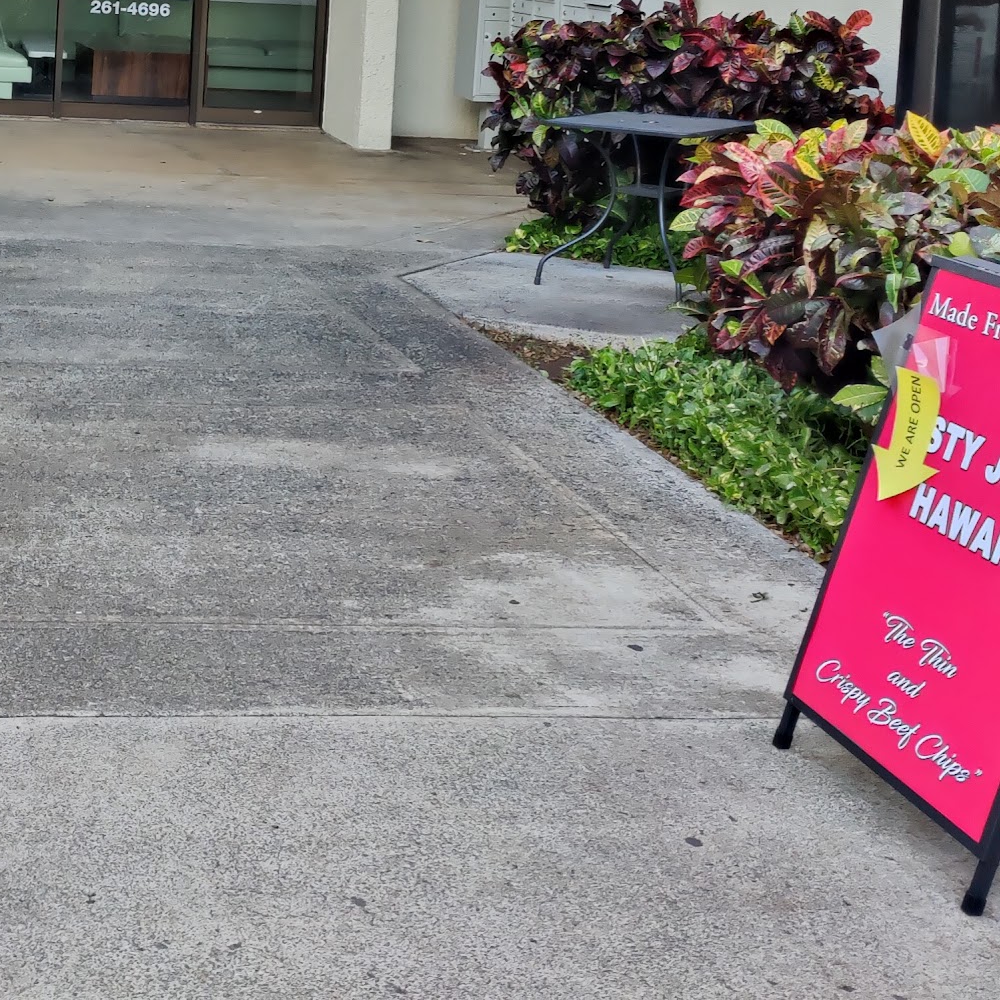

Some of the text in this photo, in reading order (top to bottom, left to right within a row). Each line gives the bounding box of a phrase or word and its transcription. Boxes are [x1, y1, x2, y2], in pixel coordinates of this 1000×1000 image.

[90, 0, 170, 17] 261-4696
[928, 292, 978, 330] Made
[896, 375, 922, 469] WE ARE OPEN
[927, 415, 986, 471] STY
[908, 482, 1000, 566] HAWAI
[919, 638, 958, 678] Thin
[816, 659, 870, 714] Crispy
[867, 698, 921, 750] Beef
[886, 671, 926, 699] and
